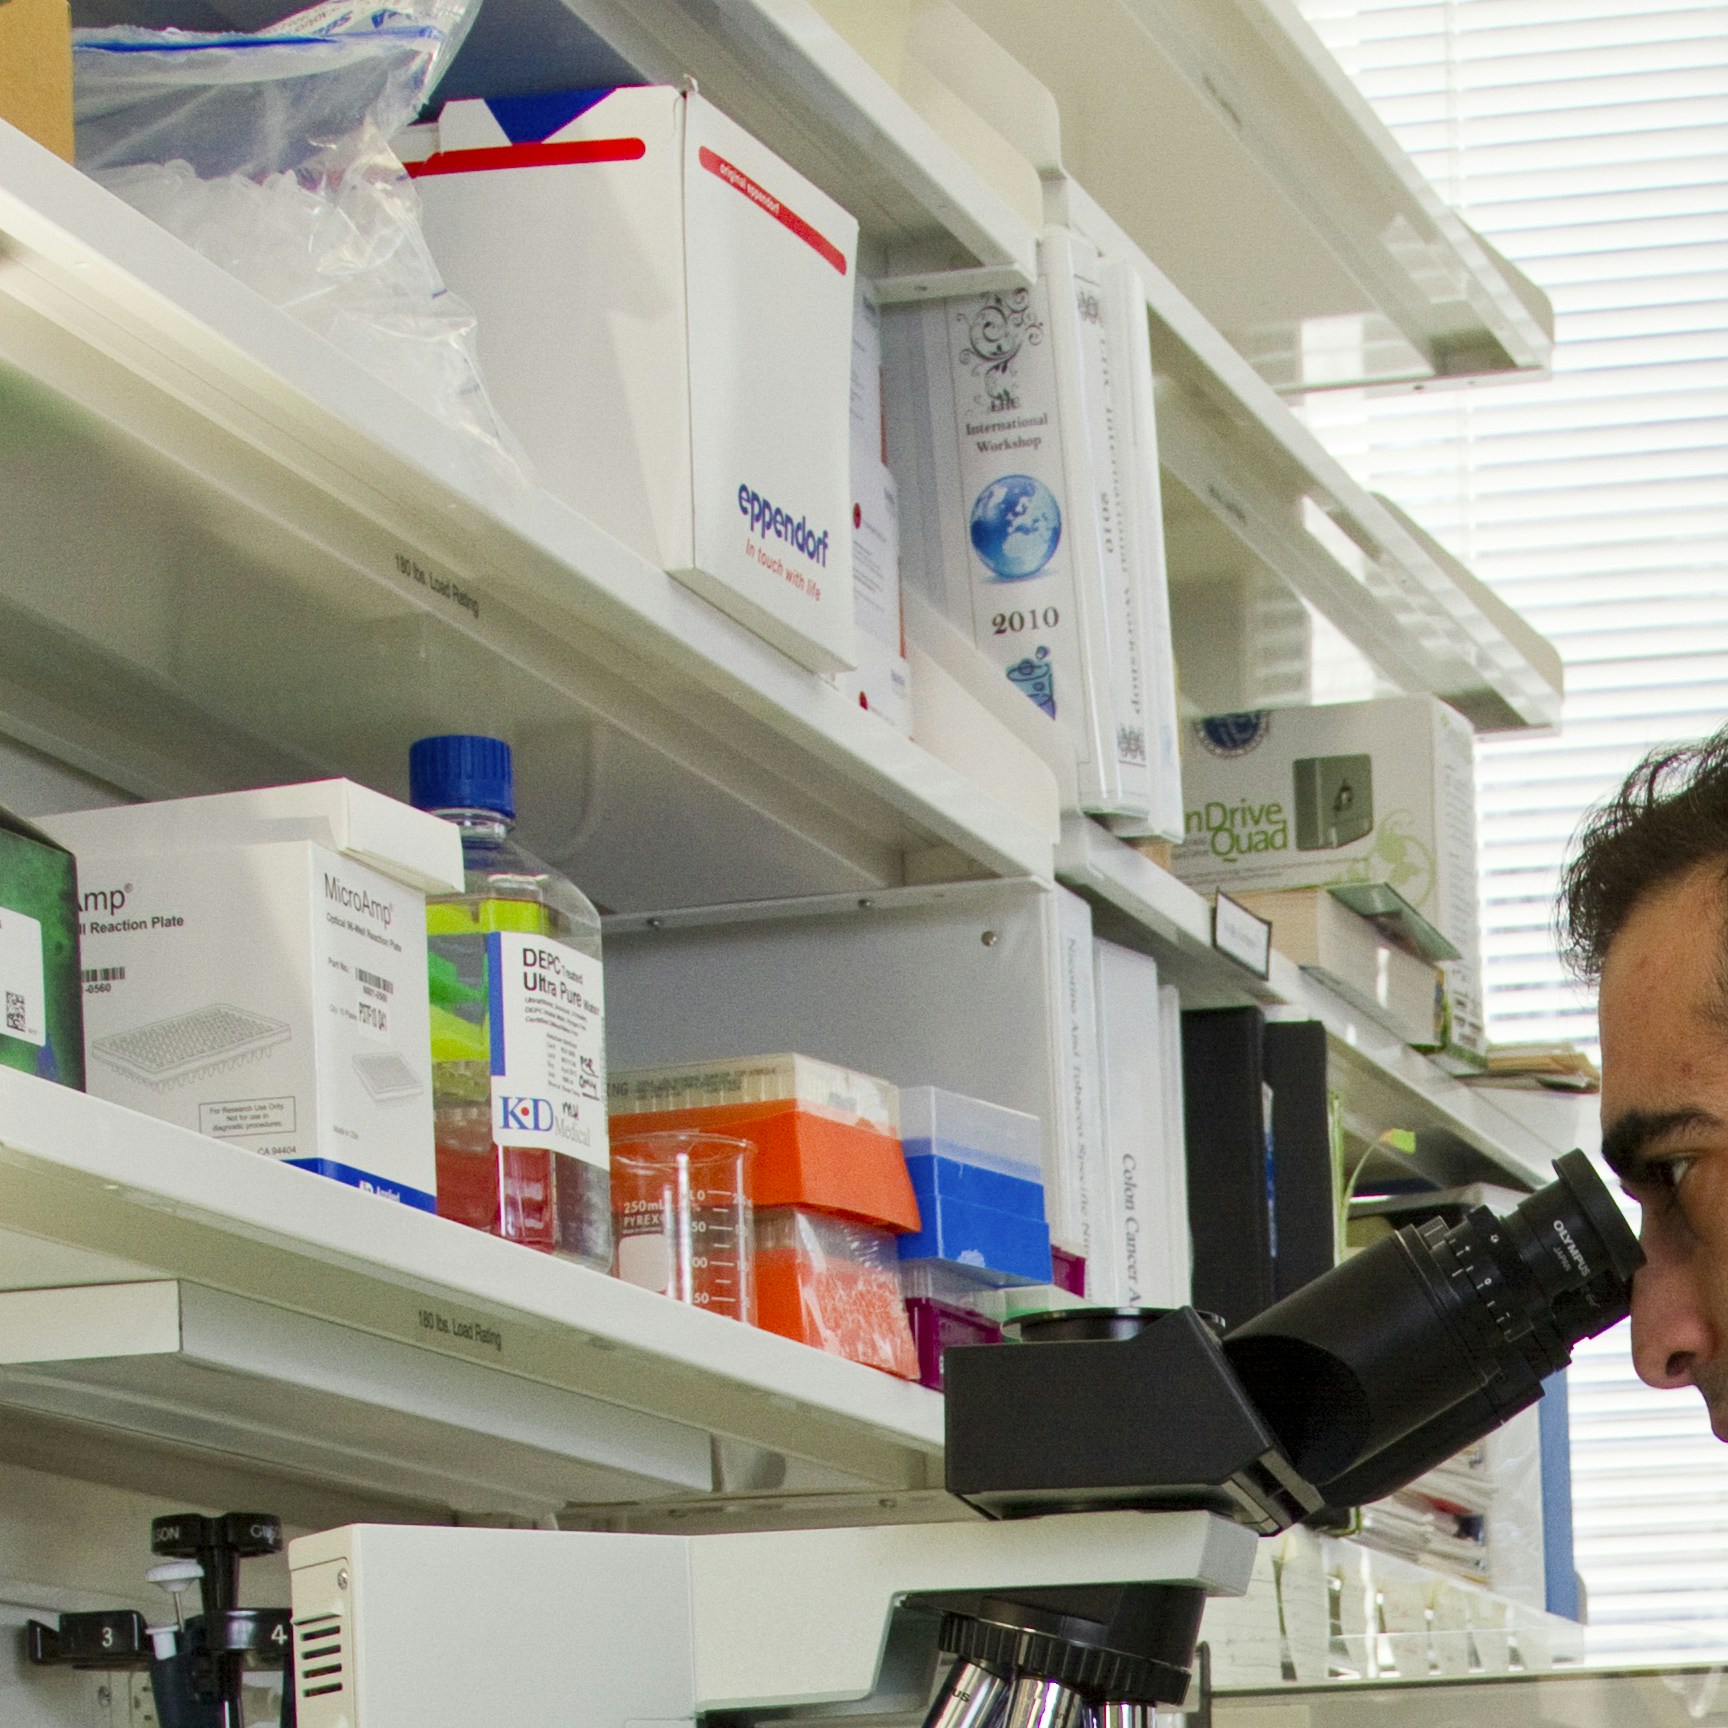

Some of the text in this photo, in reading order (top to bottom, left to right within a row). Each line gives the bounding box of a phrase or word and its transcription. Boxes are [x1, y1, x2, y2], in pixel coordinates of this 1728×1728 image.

[966, 413, 1048, 436] International
[976, 436, 1042, 454] Workshop
[738, 483, 829, 568] eppendorf
[745, 538, 822, 602] In touch with life
[429, 571, 451, 599] Load
[992, 606, 1059, 636] 2010
[1185, 798, 1283, 834] nDrive
[1210, 818, 1288, 862] Quad
[90, 916, 185, 935] Reaction Plate
[522, 948, 561, 975] DEPC
[85, 983, 112, 994] -0560
[523, 971, 557, 998] Ultra
[560, 981, 583, 1008] Pure
[209, 1103, 267, 1115] For Research Use
[226, 1112, 270, 1122] Not for use in
[212, 1122, 244, 1133] diagnostic
[555, 1115, 591, 1147] Medical
[271, 1146, 297, 1155] 94404
[1121, 1152, 1142, 1286] Colon Cancer
[1553, 1219, 1591, 1278] OLYMPUS
[1553, 1246, 1572, 1273] JAPAN
[452, 1318, 473, 1340] Load
[475, 1324, 501, 1352] Rating
[101, 1626, 114, 1648] 3
[270, 1624, 288, 1645] 4
